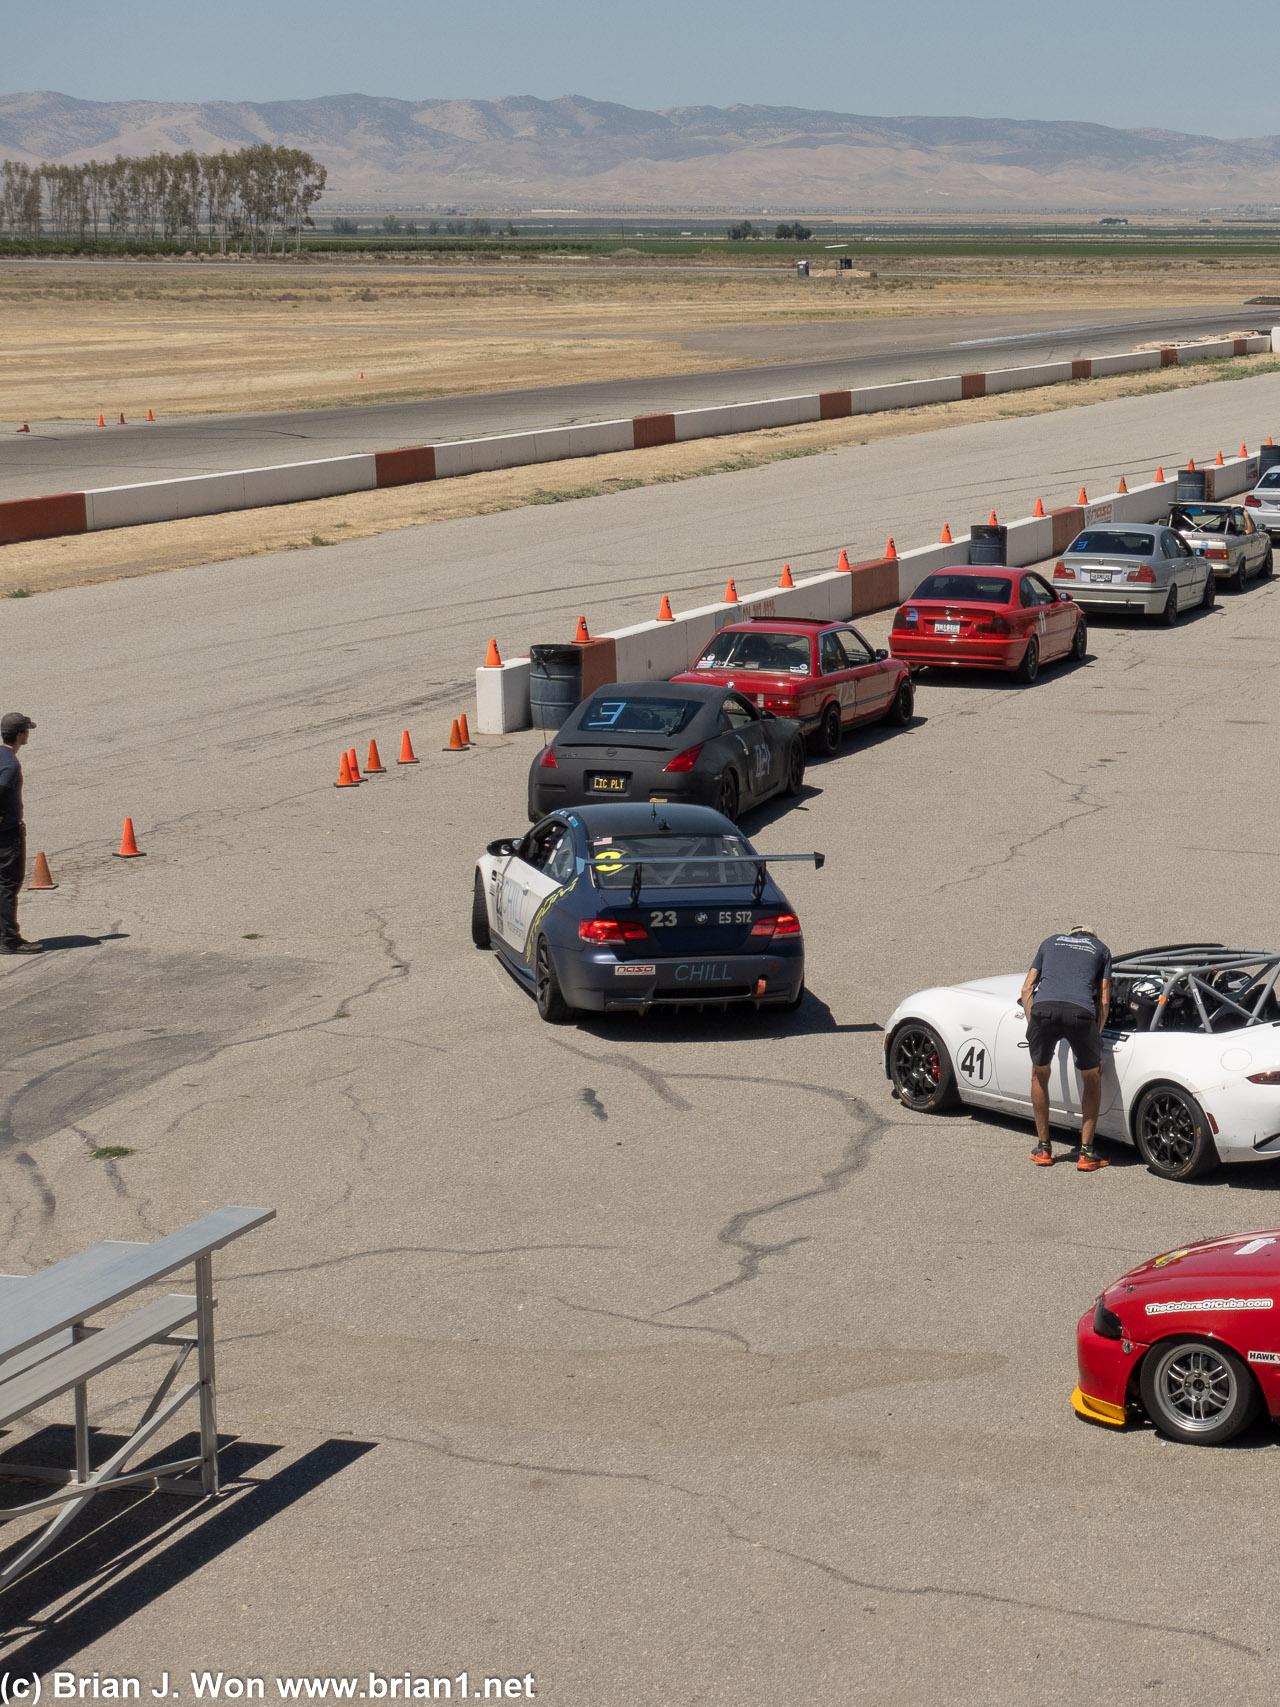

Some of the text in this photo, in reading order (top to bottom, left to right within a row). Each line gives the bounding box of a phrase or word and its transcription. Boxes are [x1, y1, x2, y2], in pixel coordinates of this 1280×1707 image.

[906, 608, 919, 622] 3
[594, 777, 625, 790] LIC PLT
[650, 910, 678, 928] 23
[719, 911, 752, 924] ES ST2
[616, 966, 654, 974] nasa
[674, 963, 732, 981] CHILL
[960, 1046, 986, 1080] 41
[1145, 1299, 1273, 1315] TheColorsOfCuba.com
[1249, 1351, 1276, 1361] HAWK
